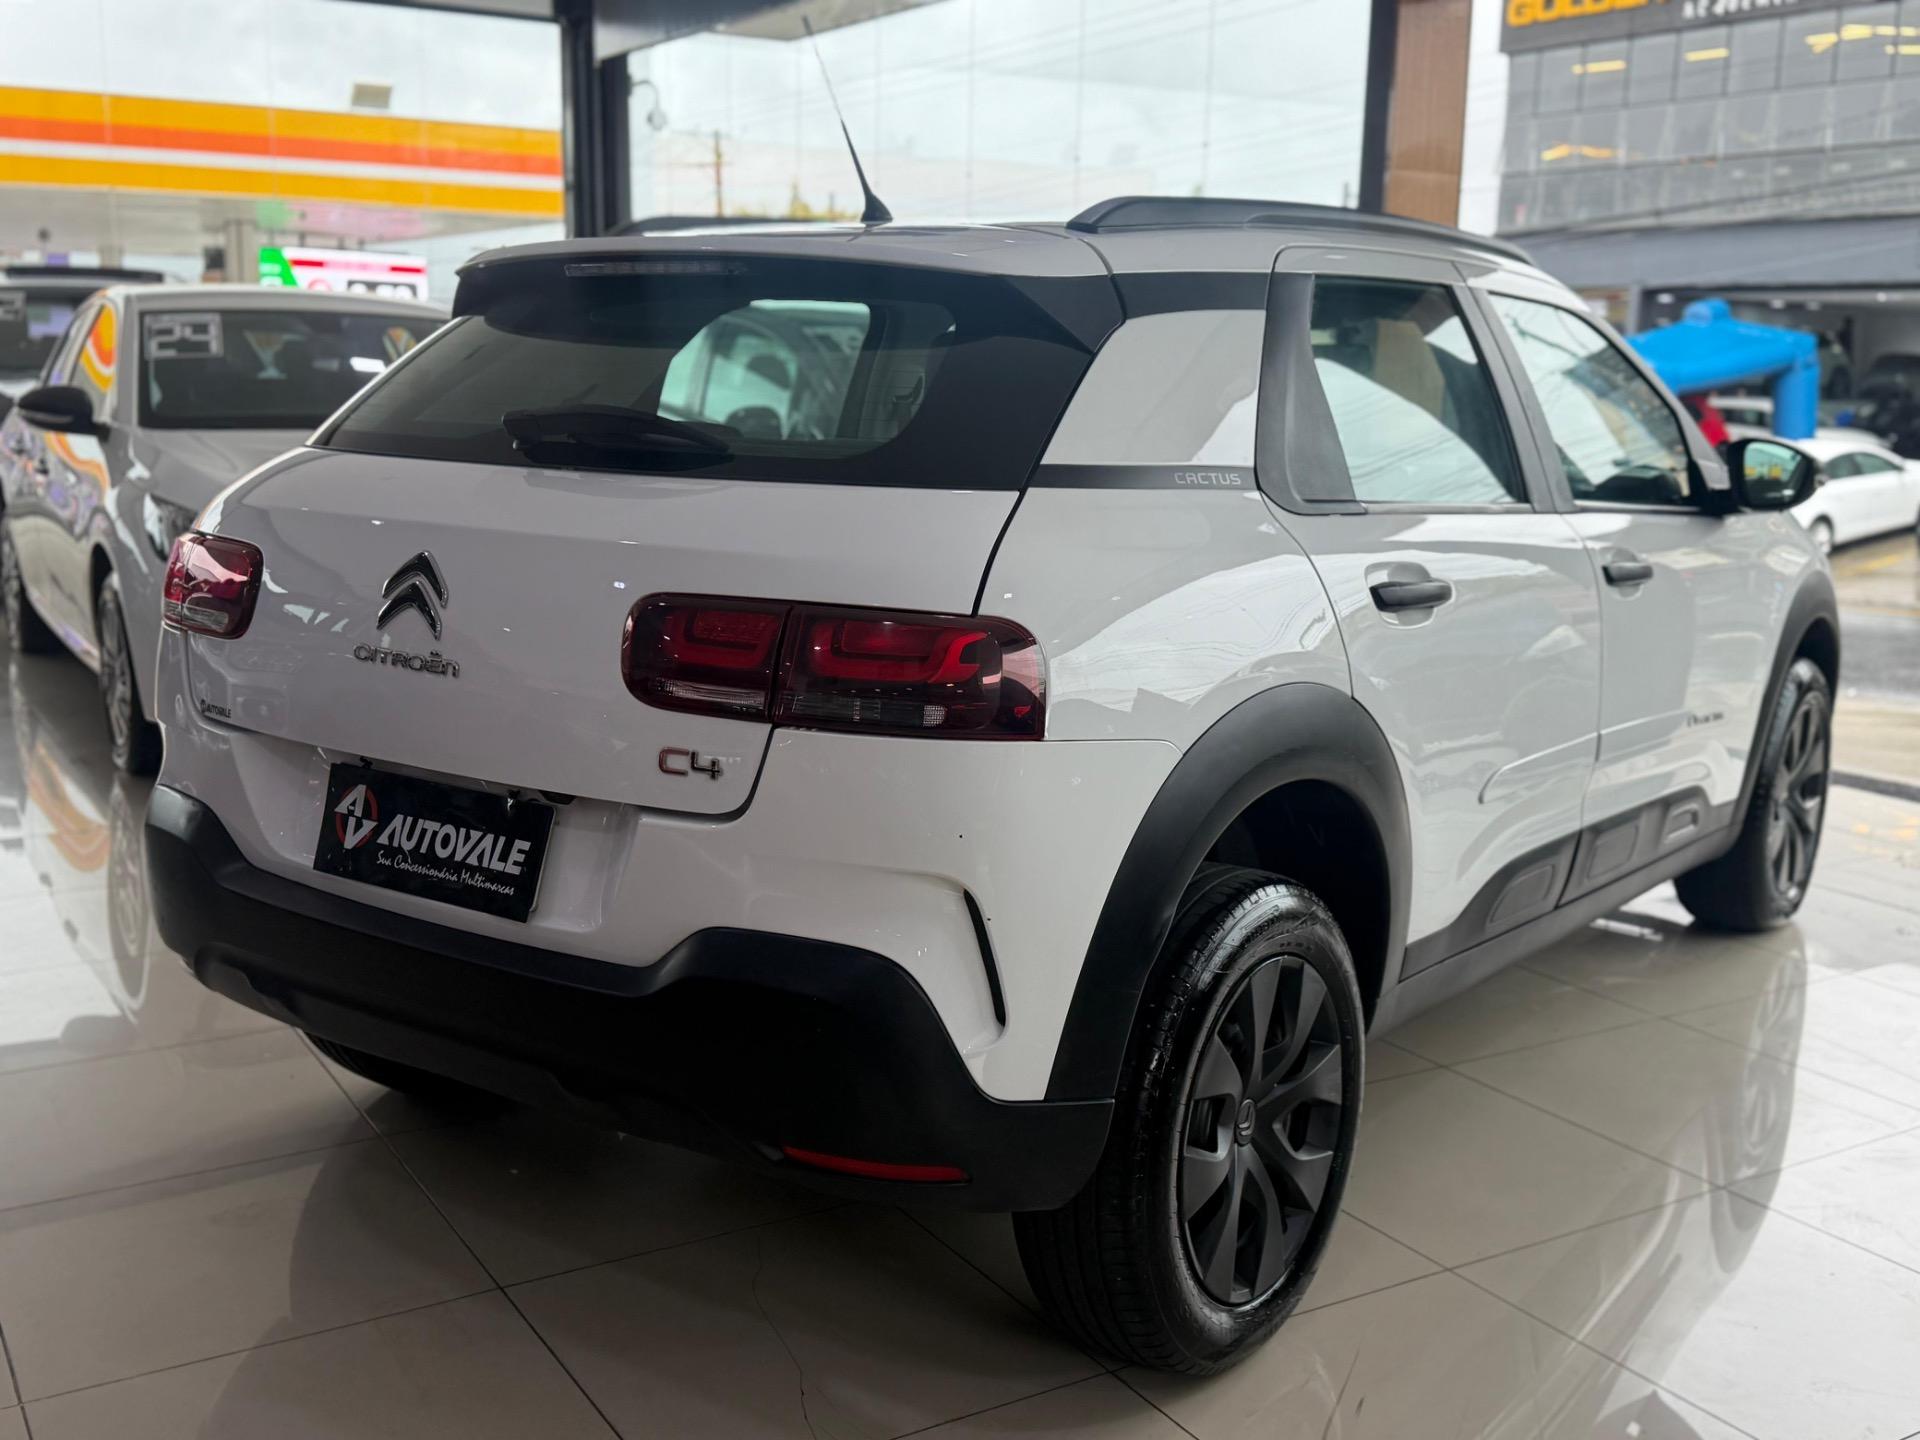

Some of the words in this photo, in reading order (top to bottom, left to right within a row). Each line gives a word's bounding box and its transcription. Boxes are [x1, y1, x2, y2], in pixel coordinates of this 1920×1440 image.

[1174, 472, 1241, 485] CACTUS
[658, 746, 724, 780] C4
[376, 814, 532, 876] AUTOVALE
[376, 850, 392, 866] Sua
[460, 868, 515, 896] Multimarcas
